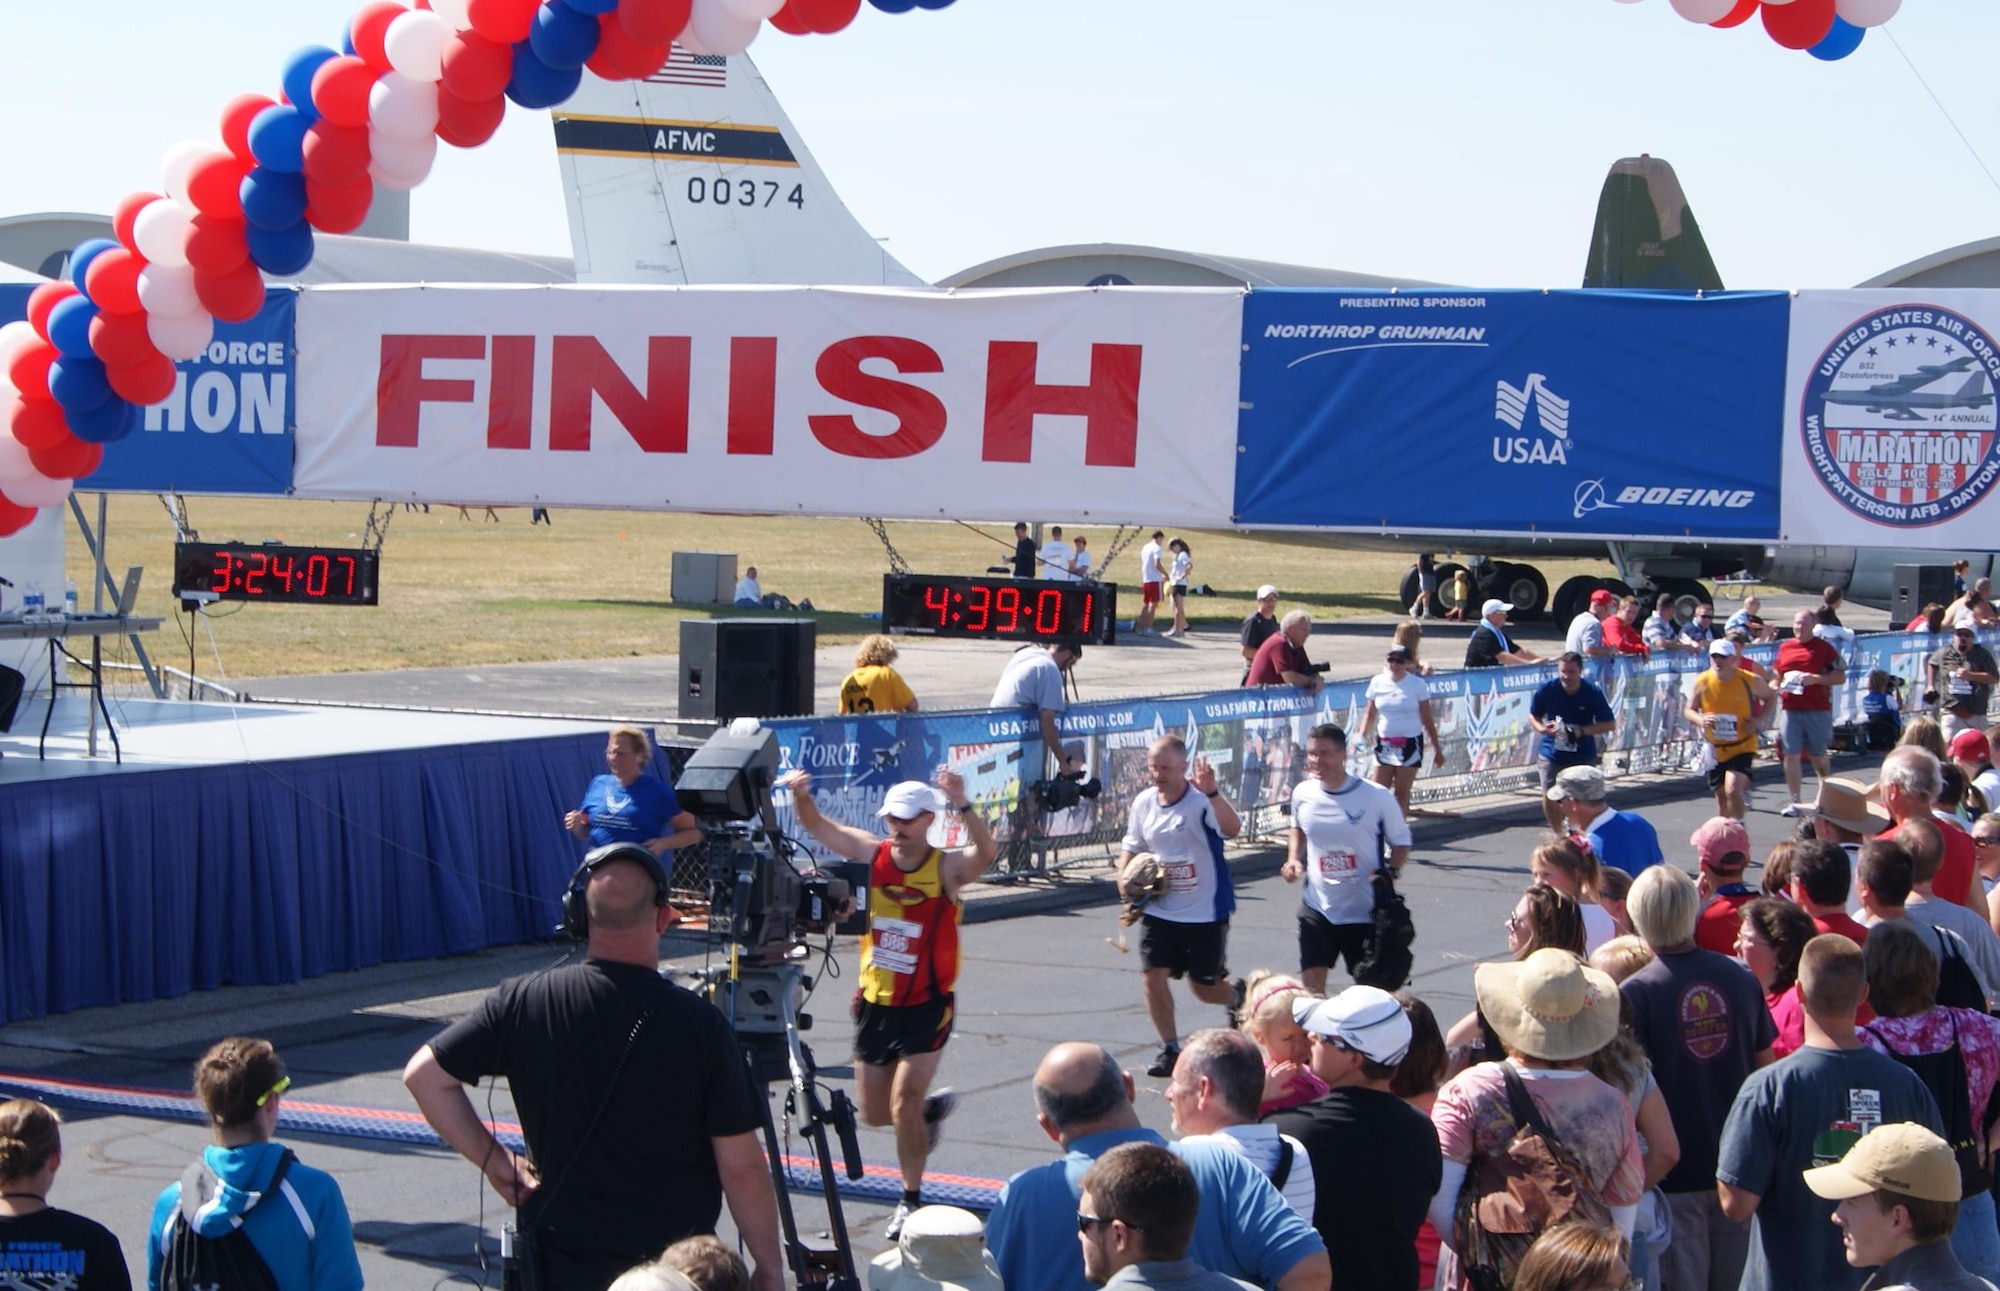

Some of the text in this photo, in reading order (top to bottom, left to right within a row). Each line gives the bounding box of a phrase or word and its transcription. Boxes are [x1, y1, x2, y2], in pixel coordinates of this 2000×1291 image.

[654, 130, 716, 152] AFMC
[688, 177, 804, 210] 00374
[1340, 298, 1486, 308] PRESENTING SPONSOR
[1264, 325, 1486, 340] NORTHROP GRUMMAN
[1820, 311, 2000, 380] UNITED STATES AIR FORCE
[375, 334, 1143, 468] FINISH
[1950, 415, 1992, 424] ANNUAL
[1838, 434, 1980, 465] MARATHON
[1806, 414, 1907, 519] WRIGHT-PATTERSON
[1910, 504, 1941, 519] AFB
[1857, 467, 1957, 480] HALF 10K 5K
[1615, 486, 1755, 508] BOEING
[1205, 696, 1315, 718] USAFMARATHON.COM
[989, 712, 1133, 737] USAFMRATHON.COM
